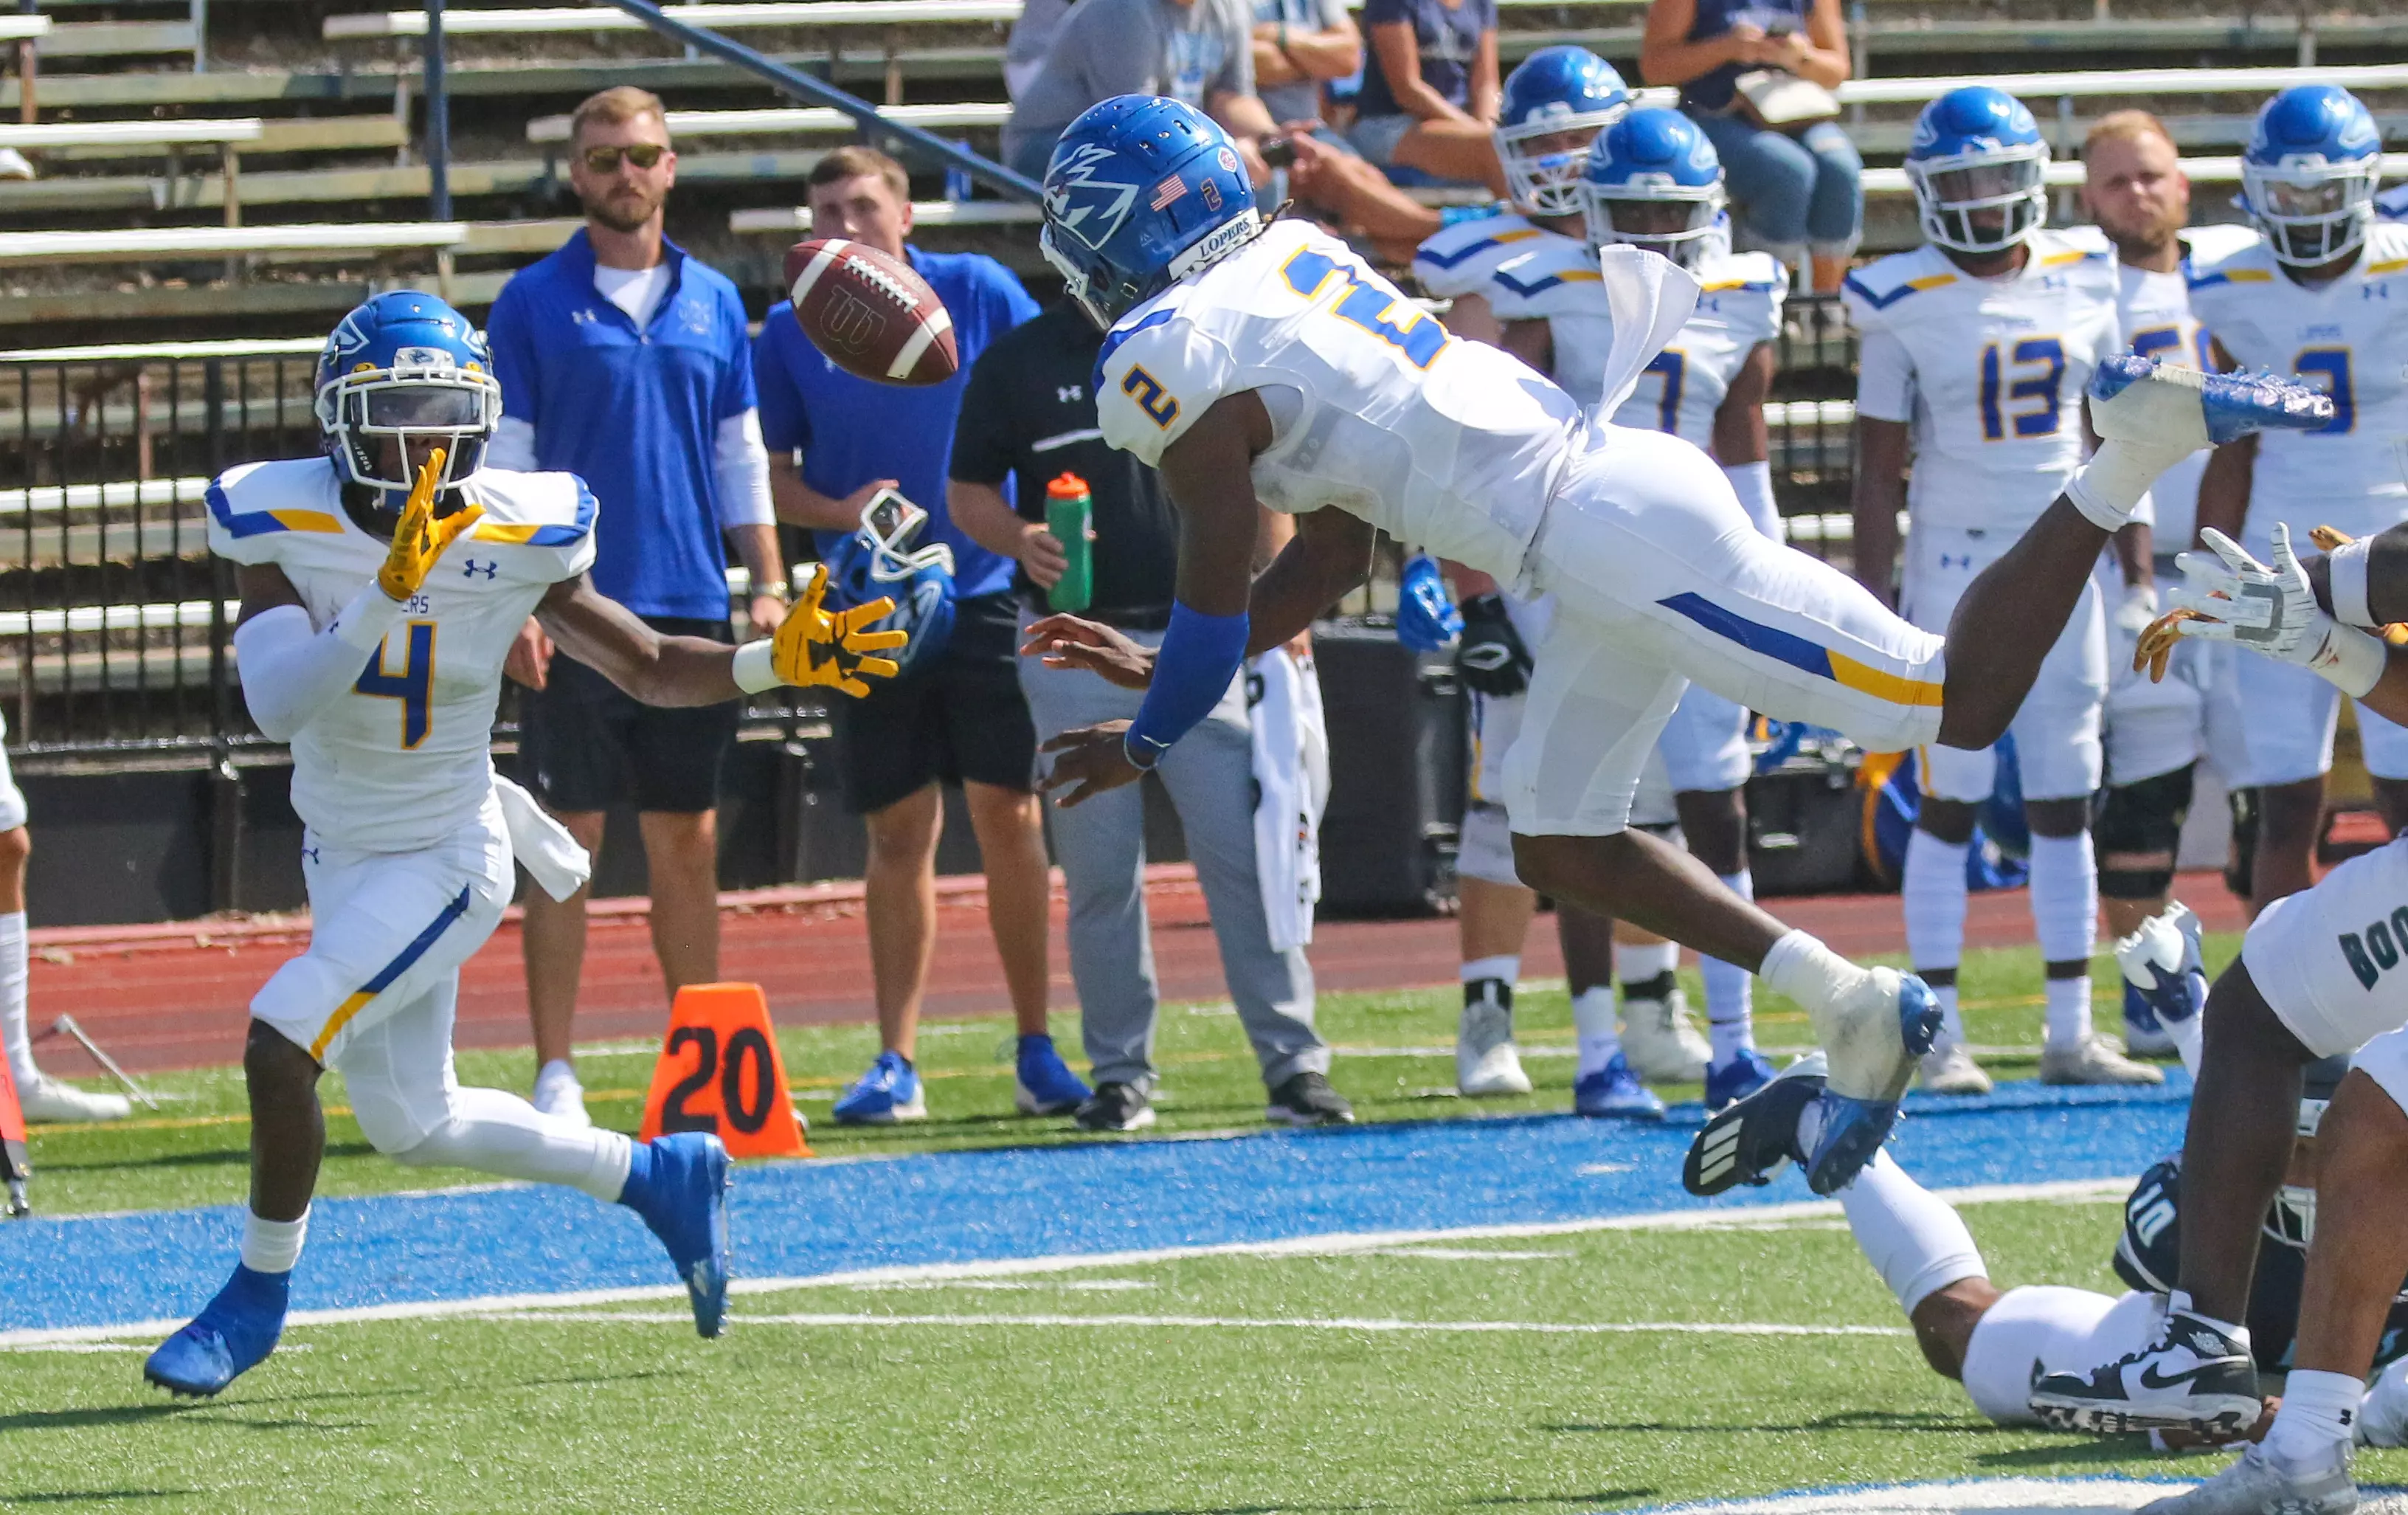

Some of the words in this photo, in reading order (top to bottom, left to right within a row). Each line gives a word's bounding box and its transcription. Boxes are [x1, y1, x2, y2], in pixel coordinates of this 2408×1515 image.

[1200, 177, 1222, 212] 2
[1200, 217, 1250, 257] LOPERS
[1278, 243, 1451, 372] 2
[1120, 362, 1180, 431] 2
[1979, 334, 2066, 441] 13
[350, 619, 438, 750] 4
[662, 1026, 775, 1134] 20
[2128, 1182, 2177, 1249] 10
